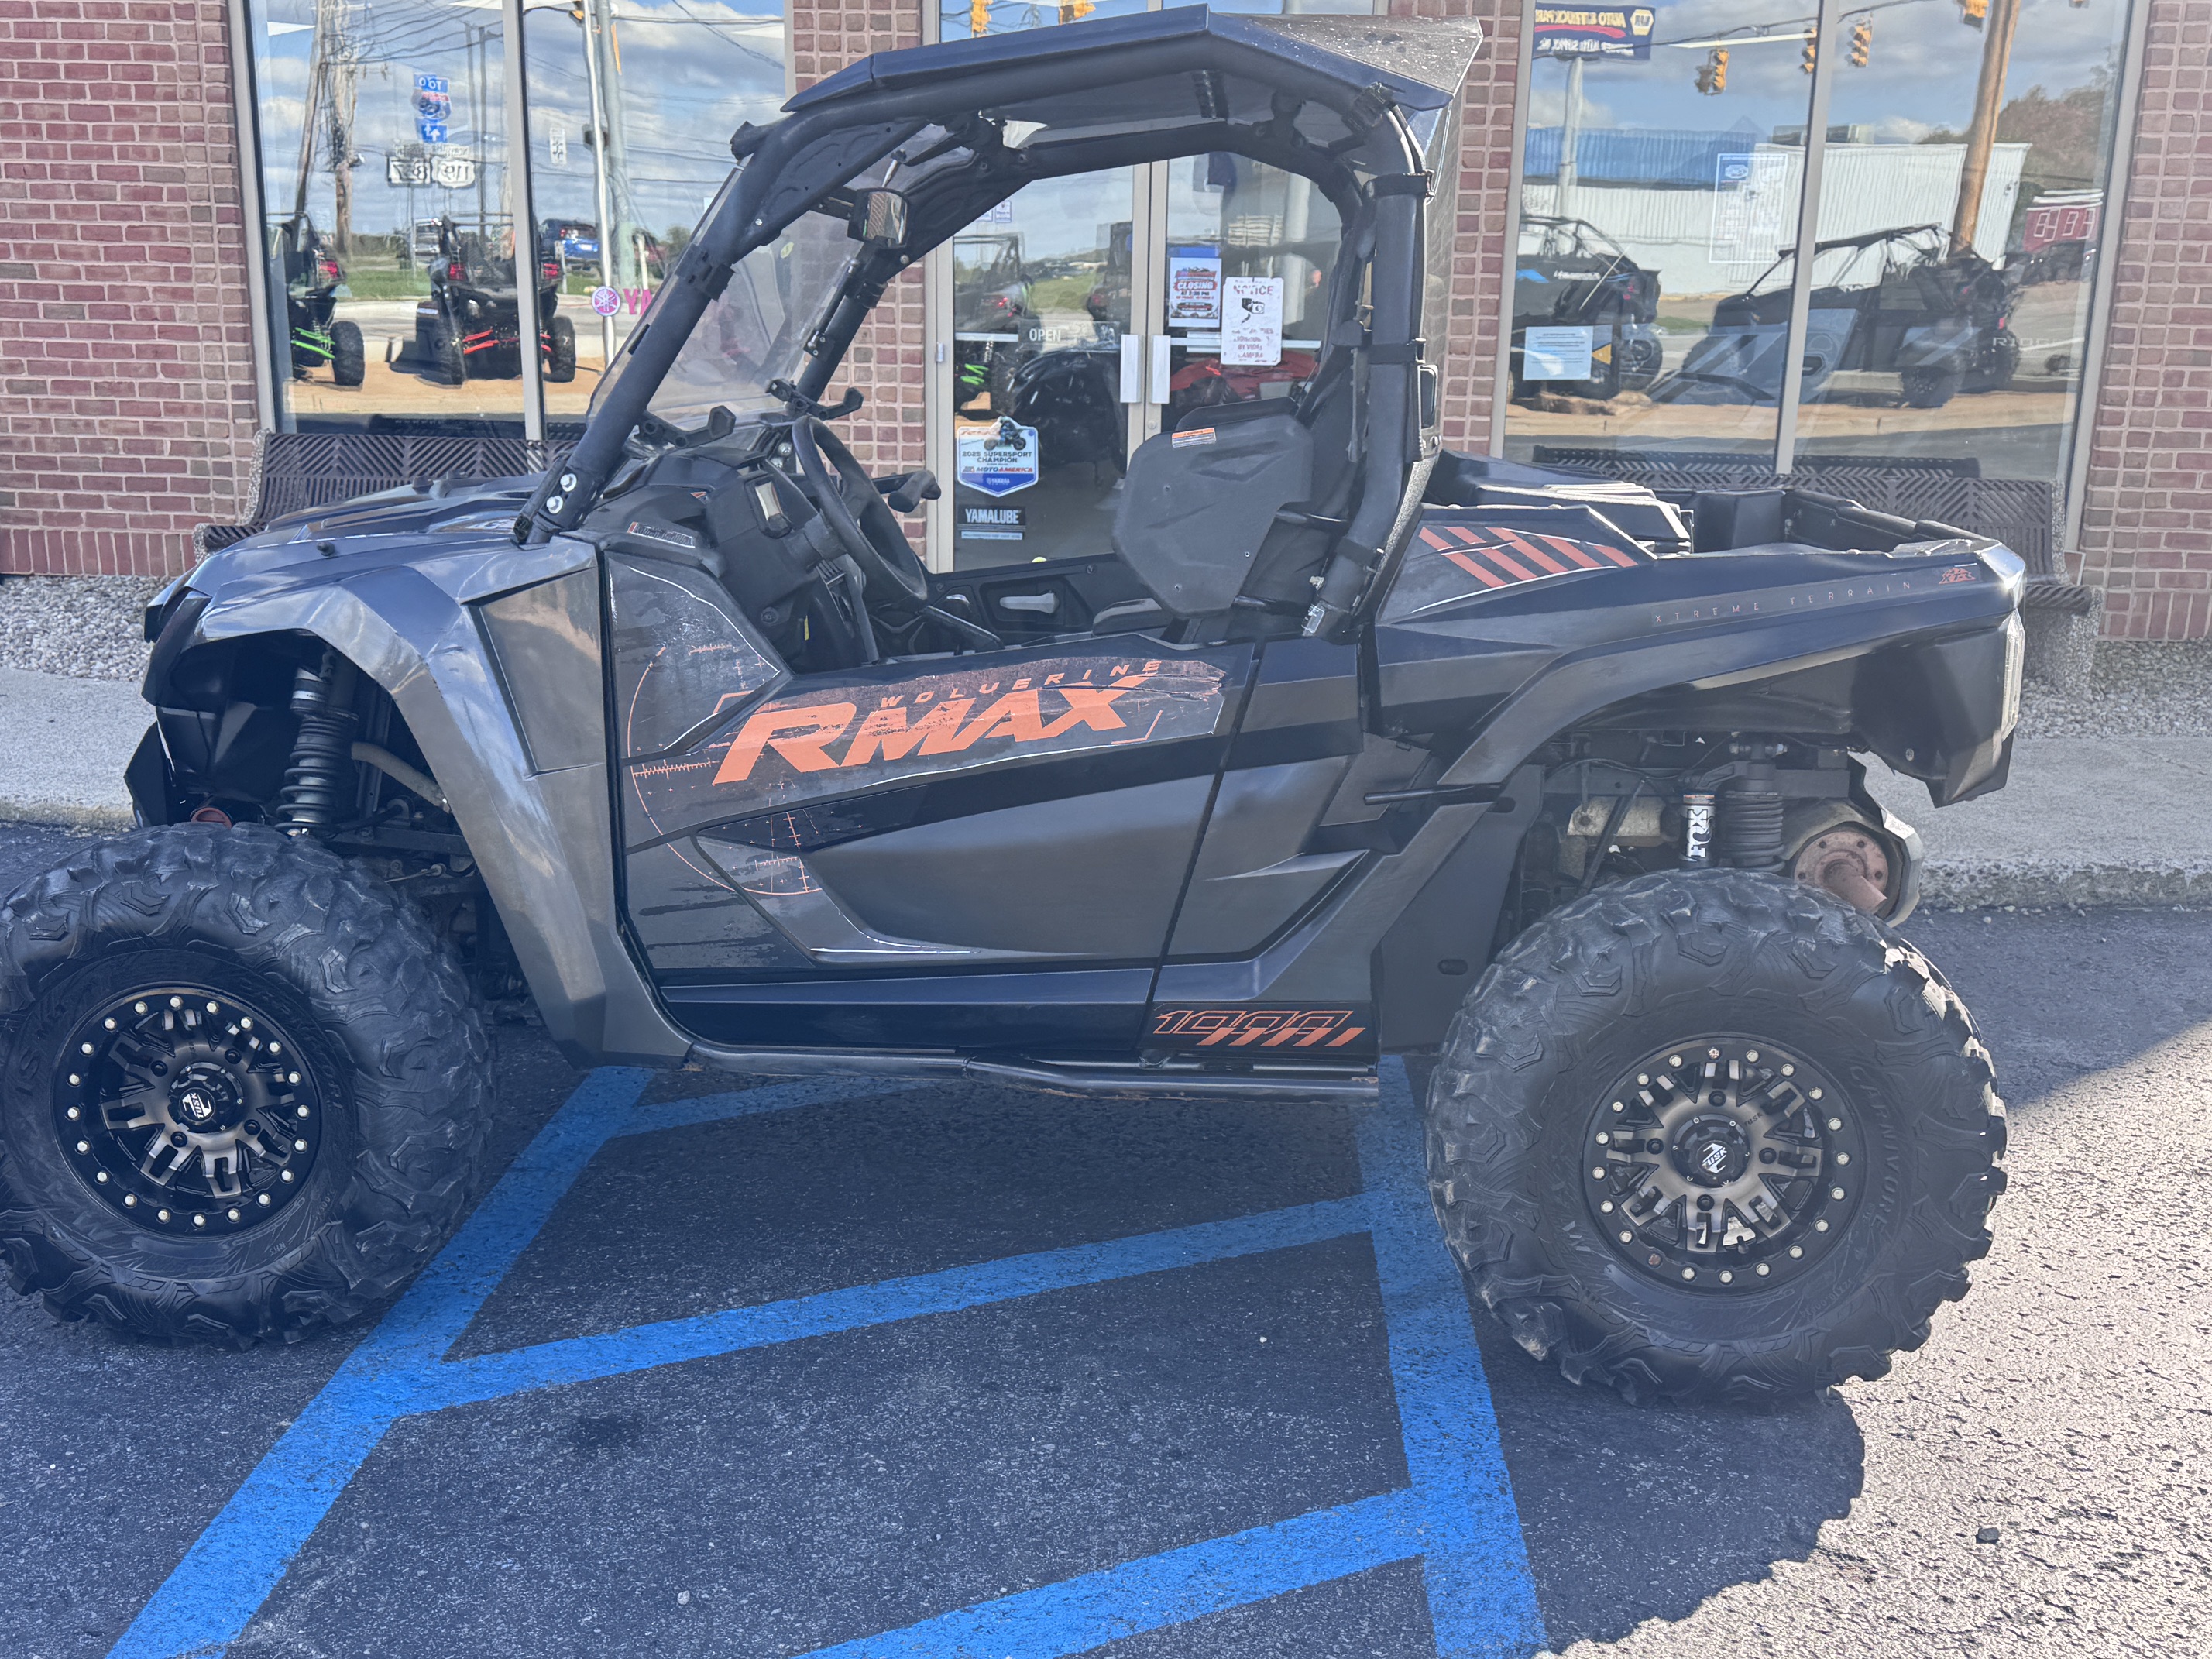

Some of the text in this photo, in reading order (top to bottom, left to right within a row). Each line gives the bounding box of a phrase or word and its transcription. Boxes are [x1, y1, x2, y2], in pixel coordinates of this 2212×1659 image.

[1177, 281, 1214, 290] CLOSING
[1029, 328, 1061, 342] OPEN
[965, 508, 1021, 524] YAMALUBE
[1655, 581, 1911, 623] XTREME TERRAIN
[712, 675, 1146, 785] RMAX
